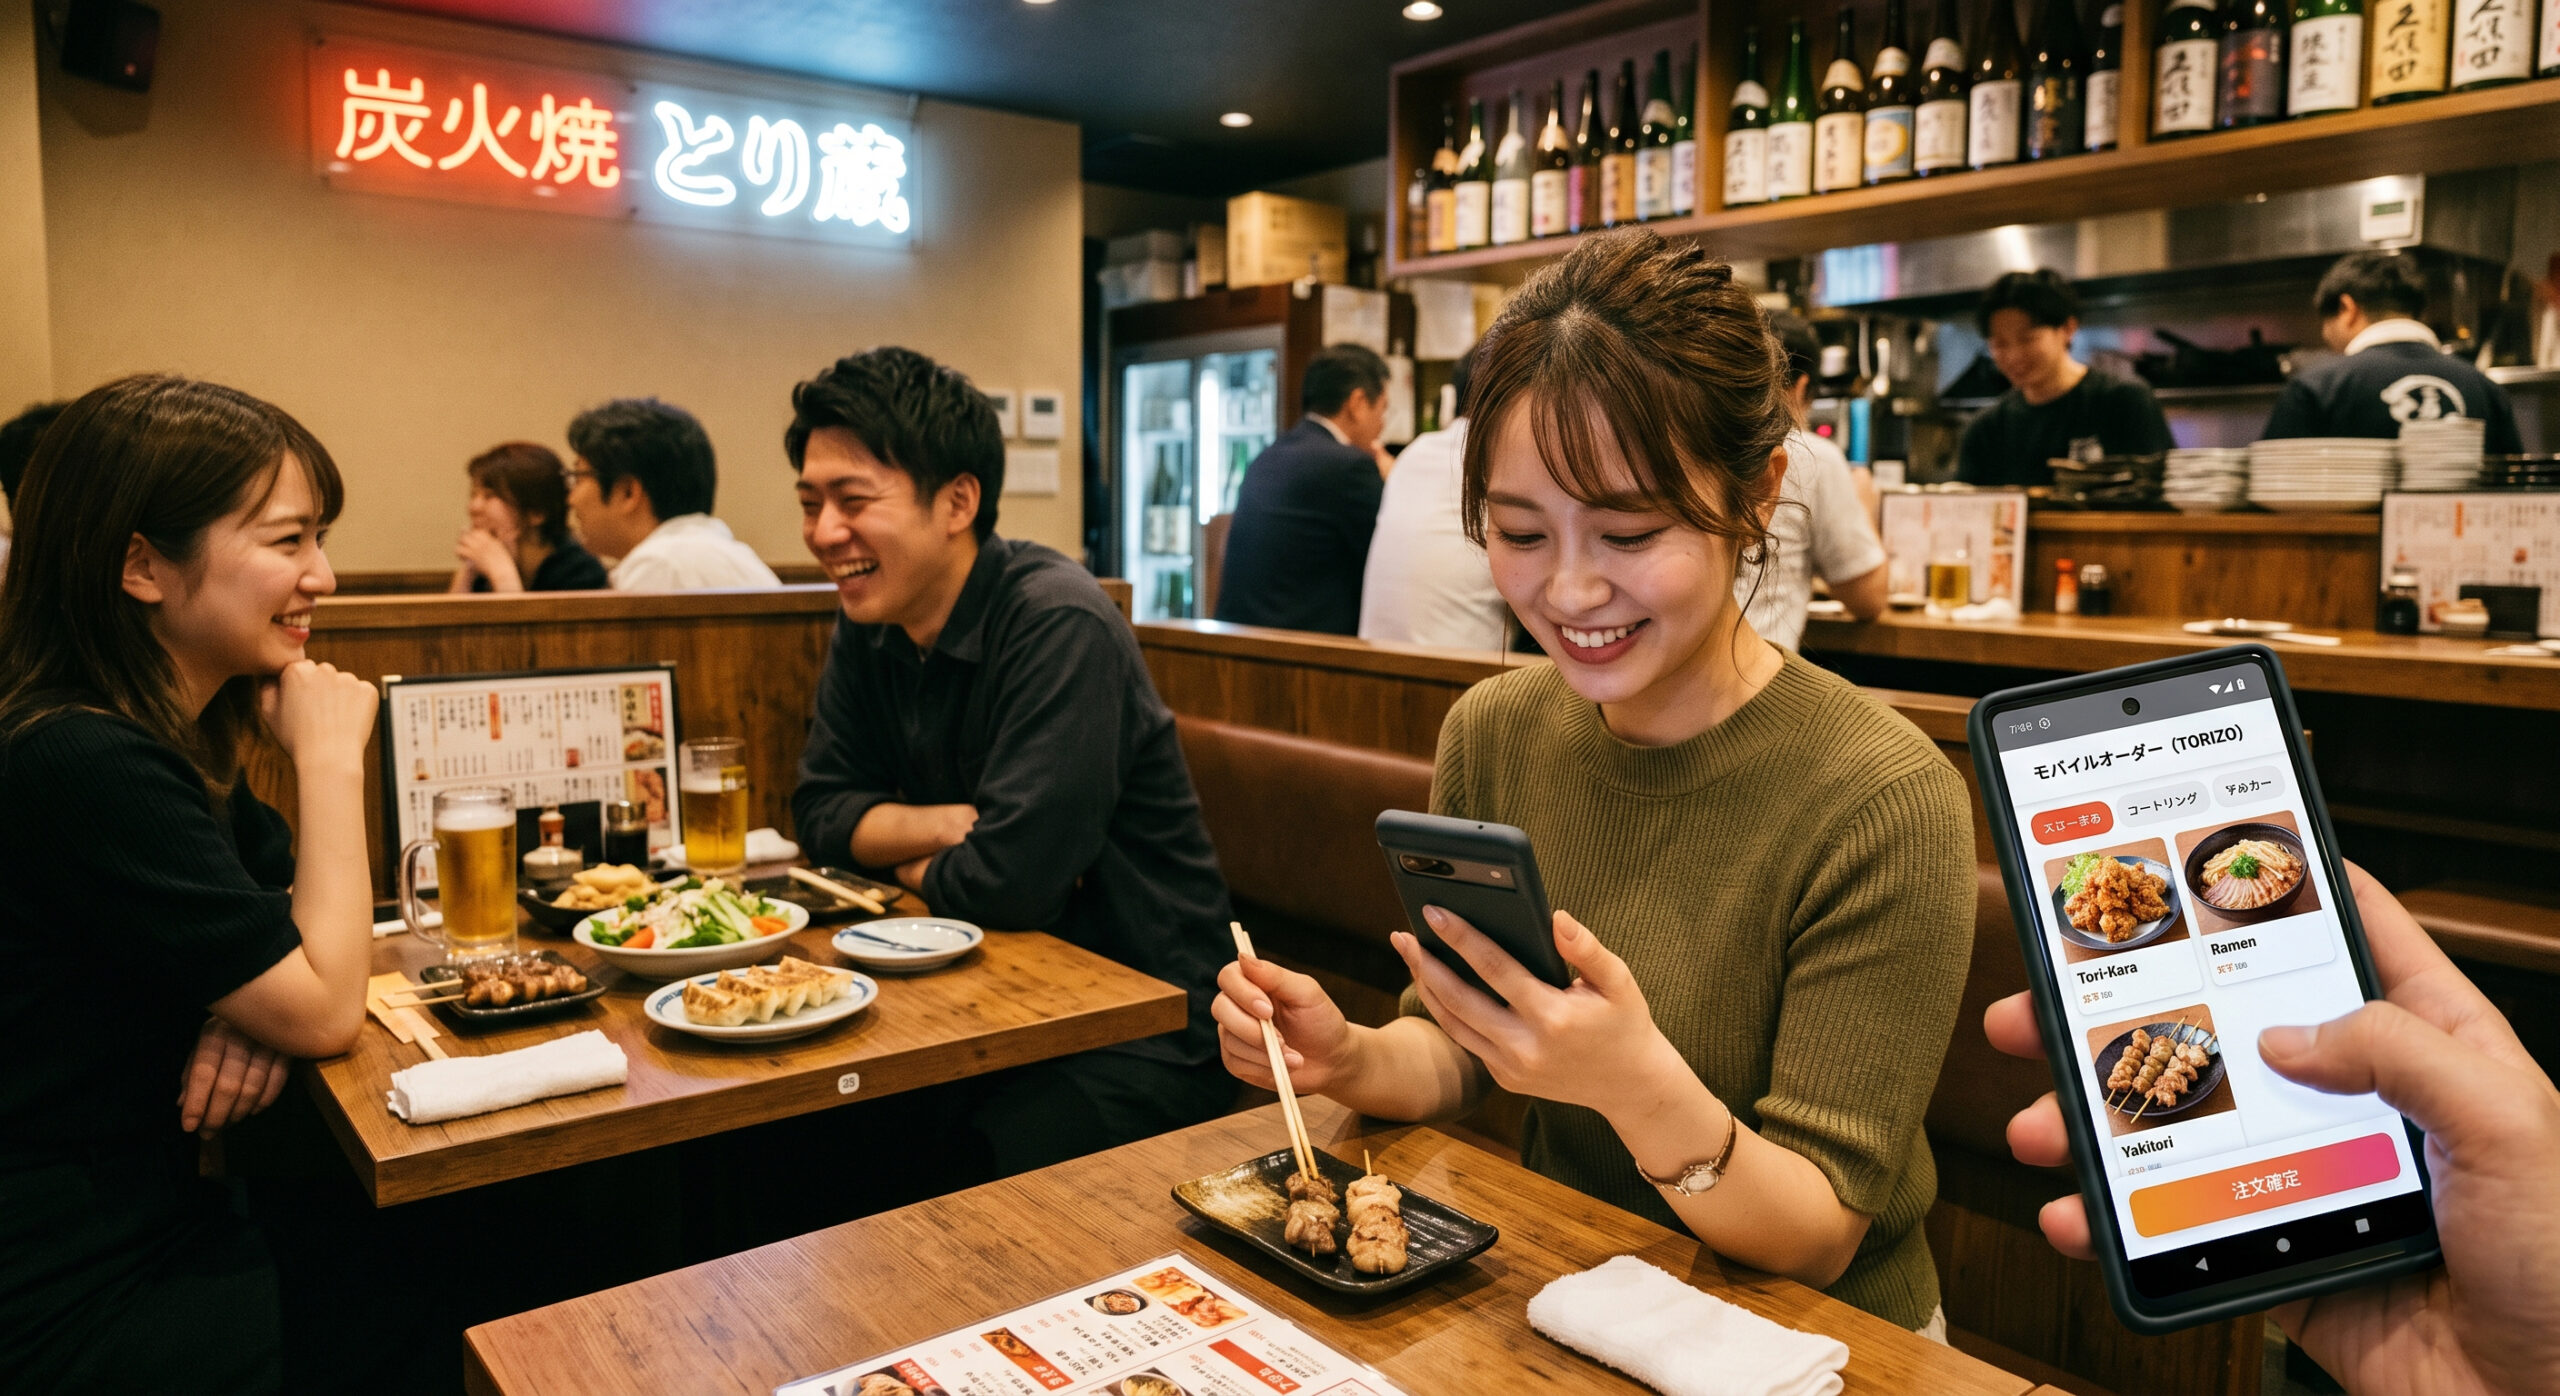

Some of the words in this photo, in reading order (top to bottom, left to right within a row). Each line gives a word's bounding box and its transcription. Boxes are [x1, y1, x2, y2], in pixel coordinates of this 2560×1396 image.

[335, 68, 621, 188] 炭火焼
[653, 101, 911, 233] とり蔵
[2034, 743, 2163, 780] モバイルオーダー
[2128, 791, 2197, 816] コートリング
[2210, 937, 2257, 956] Ramen
[2077, 963, 2138, 985] Tori-Kara
[2121, 1136, 2174, 1158] Yakitori
[2231, 1169, 2302, 1200] 注文確定
